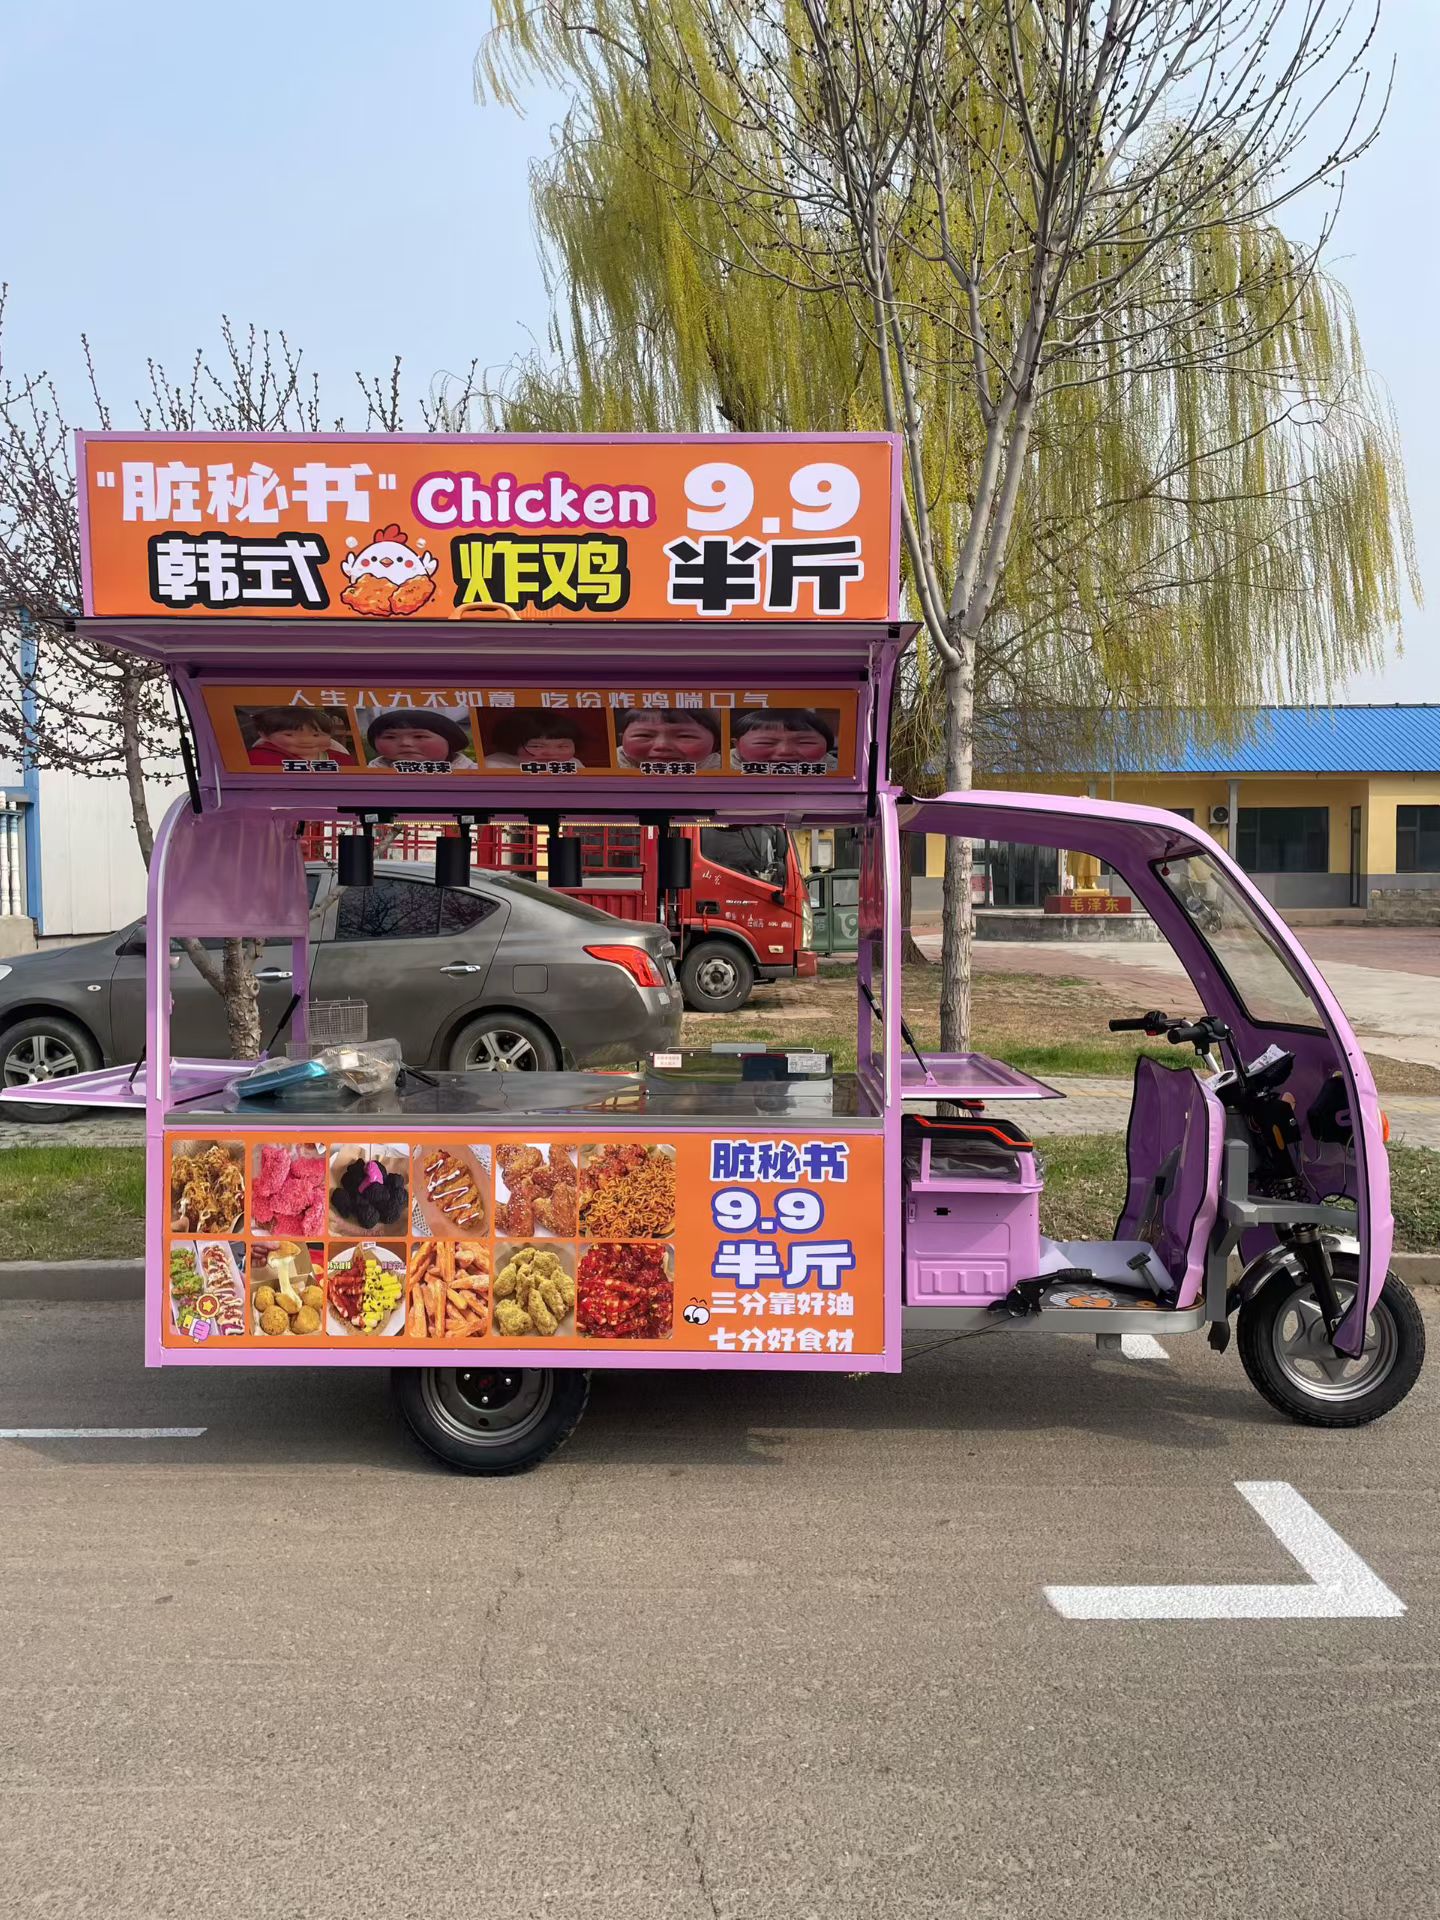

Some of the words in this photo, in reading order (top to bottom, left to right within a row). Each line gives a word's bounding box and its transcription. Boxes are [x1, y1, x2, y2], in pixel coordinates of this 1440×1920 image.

[414, 474, 654, 527] Chicken
[683, 462, 861, 534] 9.9
[153, 535, 326, 606] 韩式
[456, 537, 626, 608] 炸鸡
[664, 536, 864, 615] 半斤
[287, 689, 516, 708] 人生八九不如意
[540, 691, 770, 709] 吃份炸鸡喘口气
[282, 760, 339, 773] 五香
[394, 761, 452, 774] 微辣
[520, 762, 577, 774] 中辣
[640, 762, 697, 775] 特辣
[742, 762, 827, 775] 变态辣
[1070, 897, 1120, 912] 毛泽东
[711, 1140, 849, 1182] 脏秘书
[711, 1188, 823, 1233] 9.9
[712, 1241, 854, 1287] 半斤
[711, 1291, 855, 1316] 三分靠好油
[709, 1326, 855, 1352] 七分好食材
